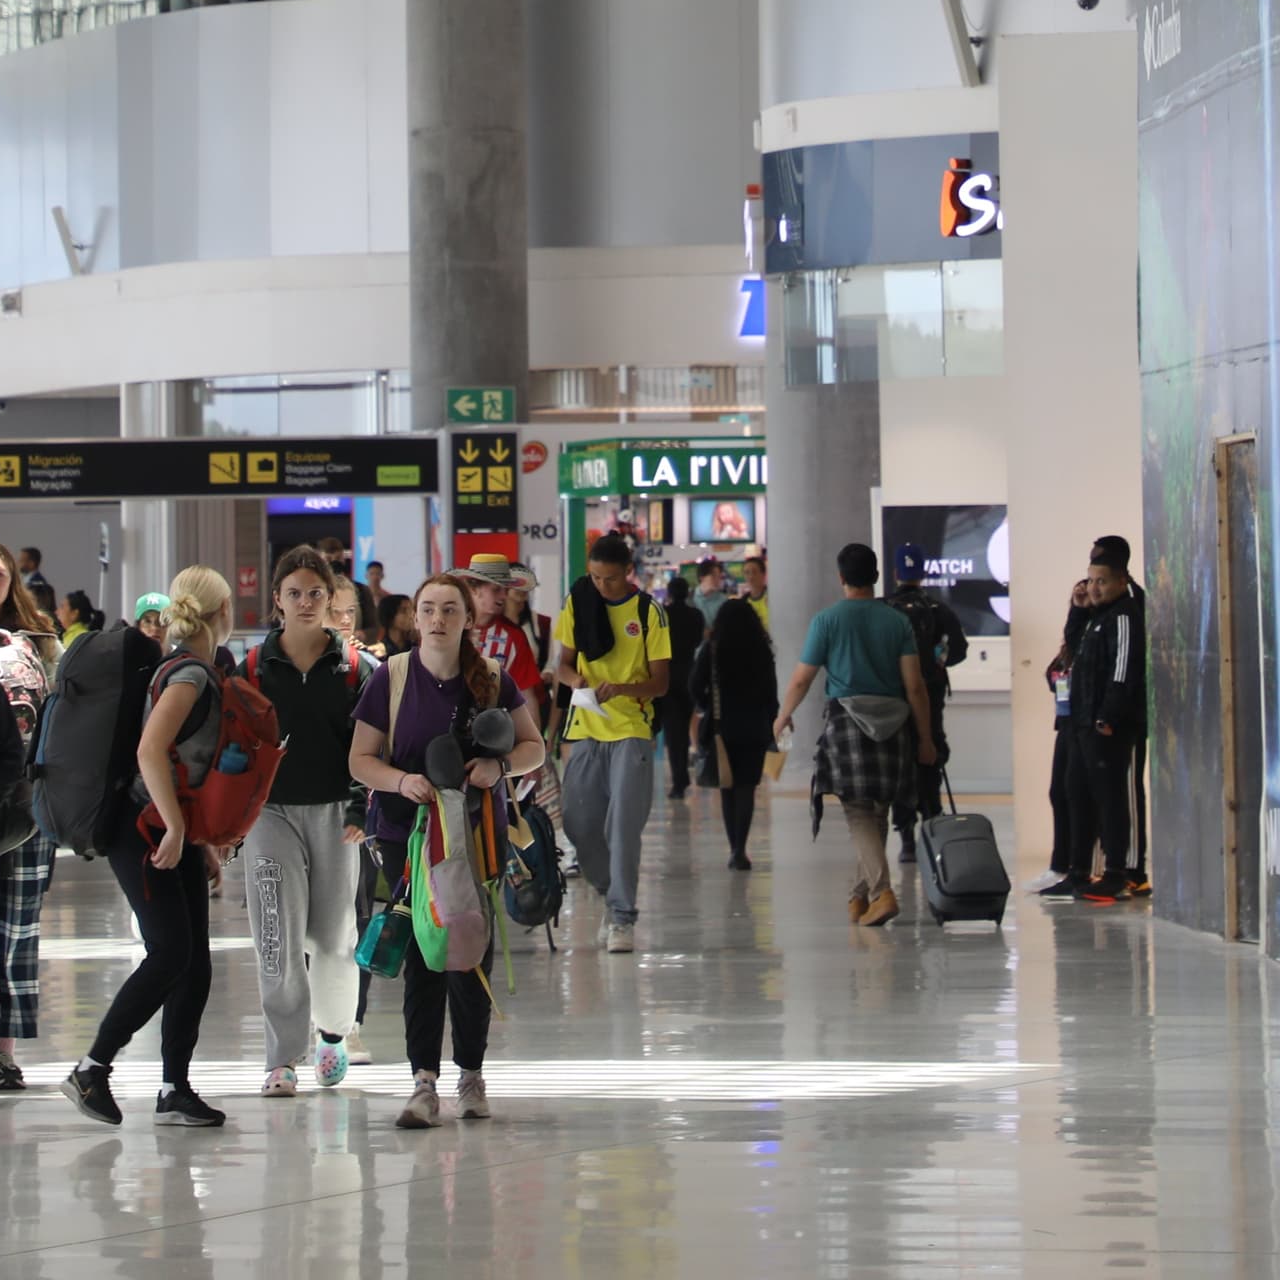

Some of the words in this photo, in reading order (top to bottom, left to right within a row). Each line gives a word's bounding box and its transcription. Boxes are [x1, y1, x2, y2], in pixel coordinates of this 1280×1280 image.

[28, 456, 83, 468] Migración
[632, 455, 678, 487] LA
[487, 496, 510, 507] Exit
